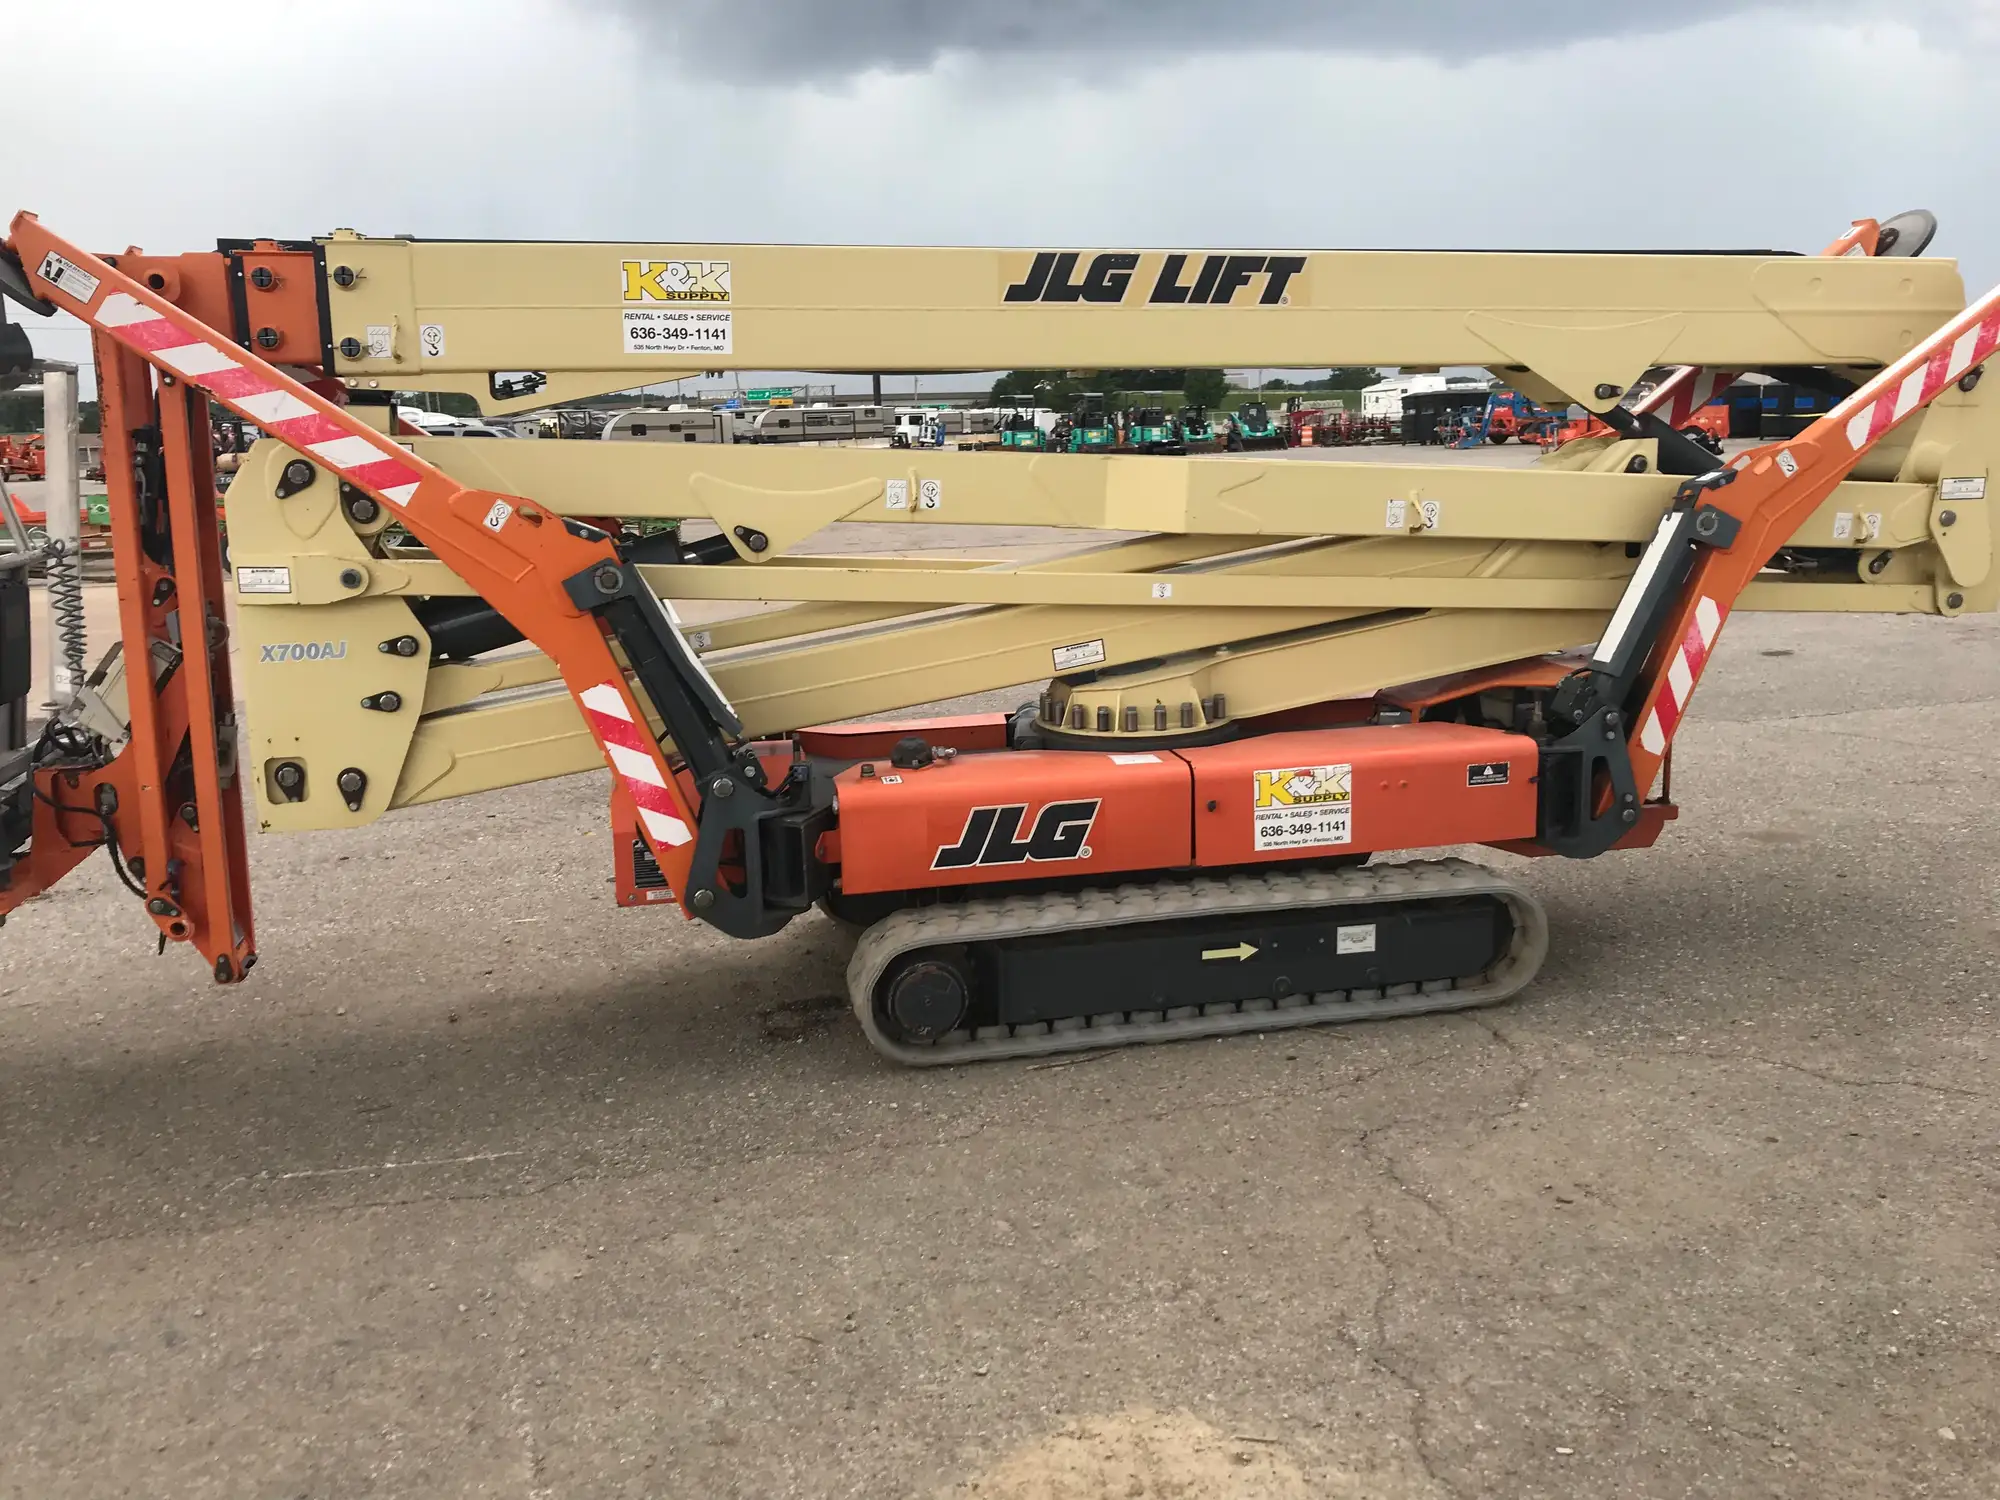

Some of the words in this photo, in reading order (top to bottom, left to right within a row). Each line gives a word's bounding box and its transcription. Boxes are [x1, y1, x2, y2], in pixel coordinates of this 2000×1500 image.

[622, 261, 729, 301] K&K
[1002, 252, 1141, 302] JLG
[1148, 254, 1308, 304] LIFT
[666, 292, 728, 301] SUPPLY
[624, 313, 655, 321] RENTAL
[663, 313, 689, 321] SALES
[696, 314, 731, 322] SERVICE
[630, 327, 727, 340] 636-349-1141
[259, 640, 347, 663] X700AJ
[1293, 792, 1348, 803] SUPPLY
[1255, 813, 1283, 821] RENTAL
[1290, 810, 1313, 818] SALES
[1319, 807, 1350, 816] SERVICE
[930, 798, 1102, 870] JLG
[1260, 820, 1346, 837] 636-349-1141
